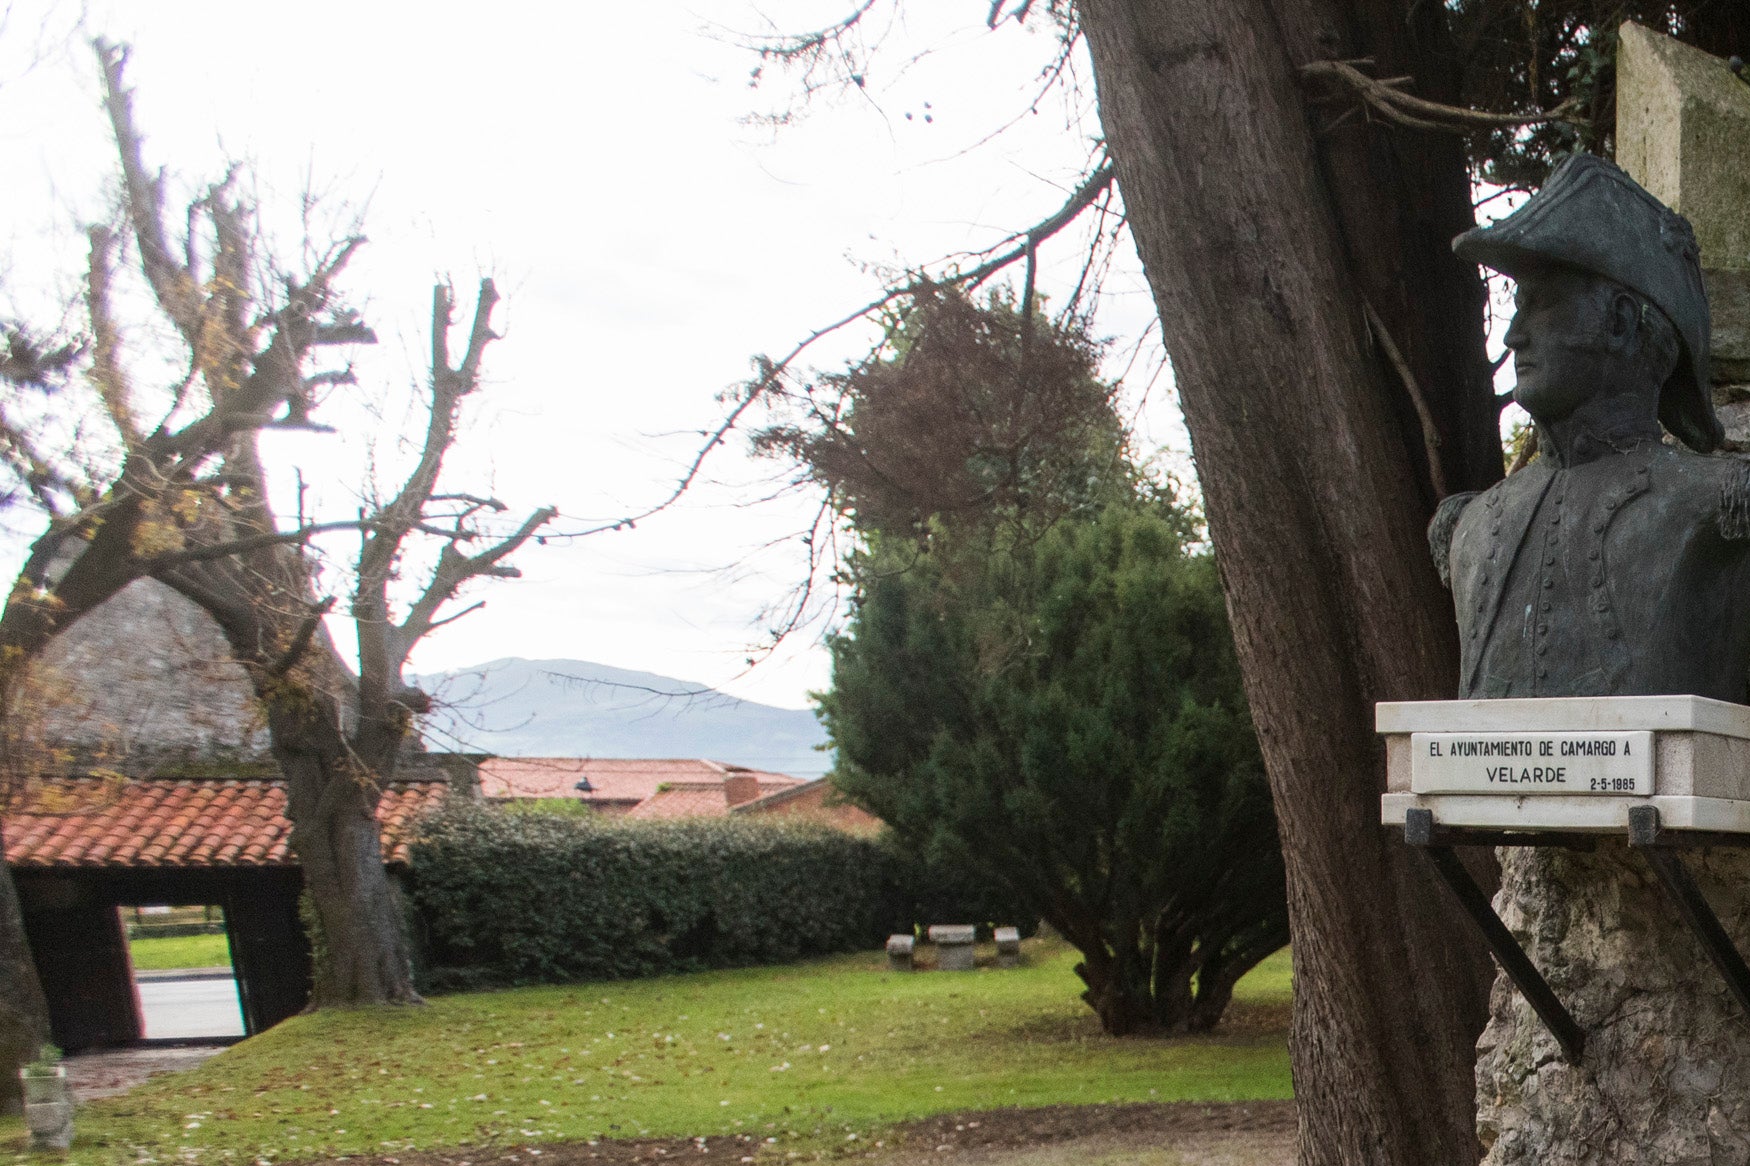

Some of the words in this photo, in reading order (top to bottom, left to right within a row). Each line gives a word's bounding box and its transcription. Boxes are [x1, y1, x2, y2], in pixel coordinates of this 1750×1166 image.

[1430, 742, 1443, 757] EL
[1450, 741, 1532, 757] AYUNTAMIENTO
[1539, 741, 1554, 756] DE
[1561, 741, 1616, 756] CAMARGO
[1624, 741, 1631, 756] A
[1486, 767, 1566, 783] VELARDE
[1590, 778, 1635, 791] 2-5-1985
